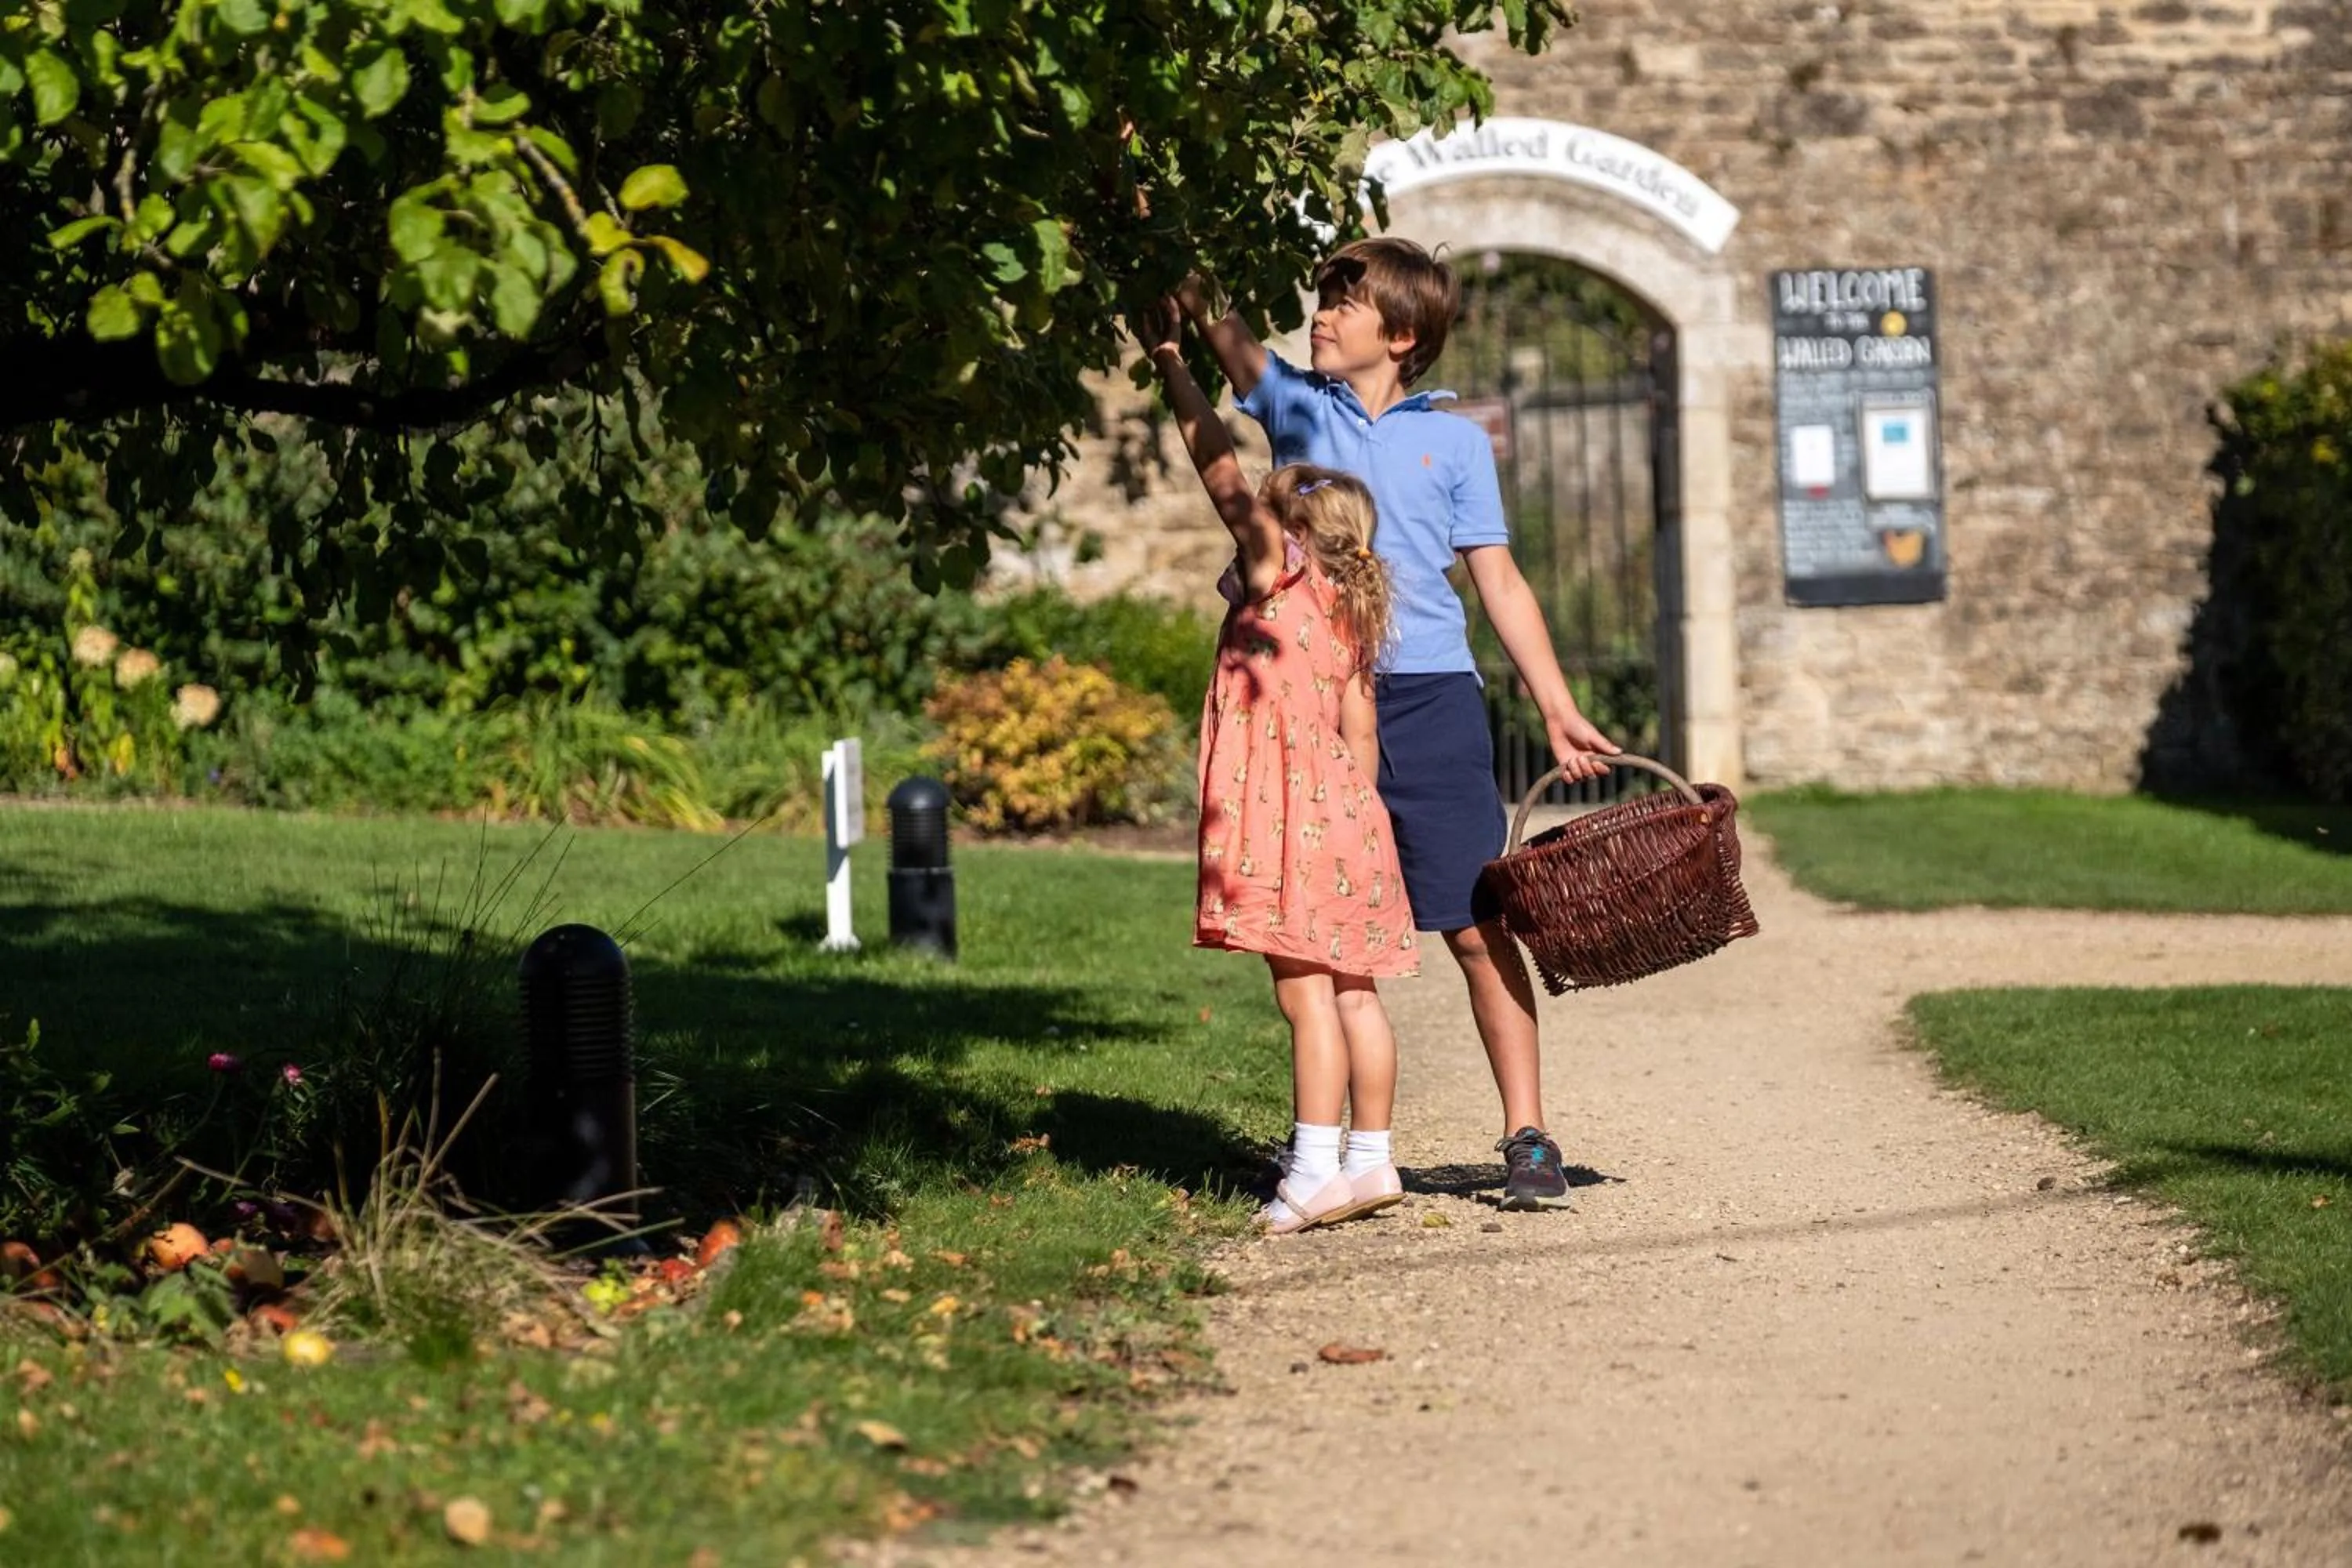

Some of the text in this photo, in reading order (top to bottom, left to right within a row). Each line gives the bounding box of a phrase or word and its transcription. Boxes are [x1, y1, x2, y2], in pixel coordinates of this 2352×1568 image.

[1406, 128, 1699, 218] Walled Garden
[1779, 268, 1928, 314] WELCOME
[1777, 335, 1931, 369] WALLED GARDEN
